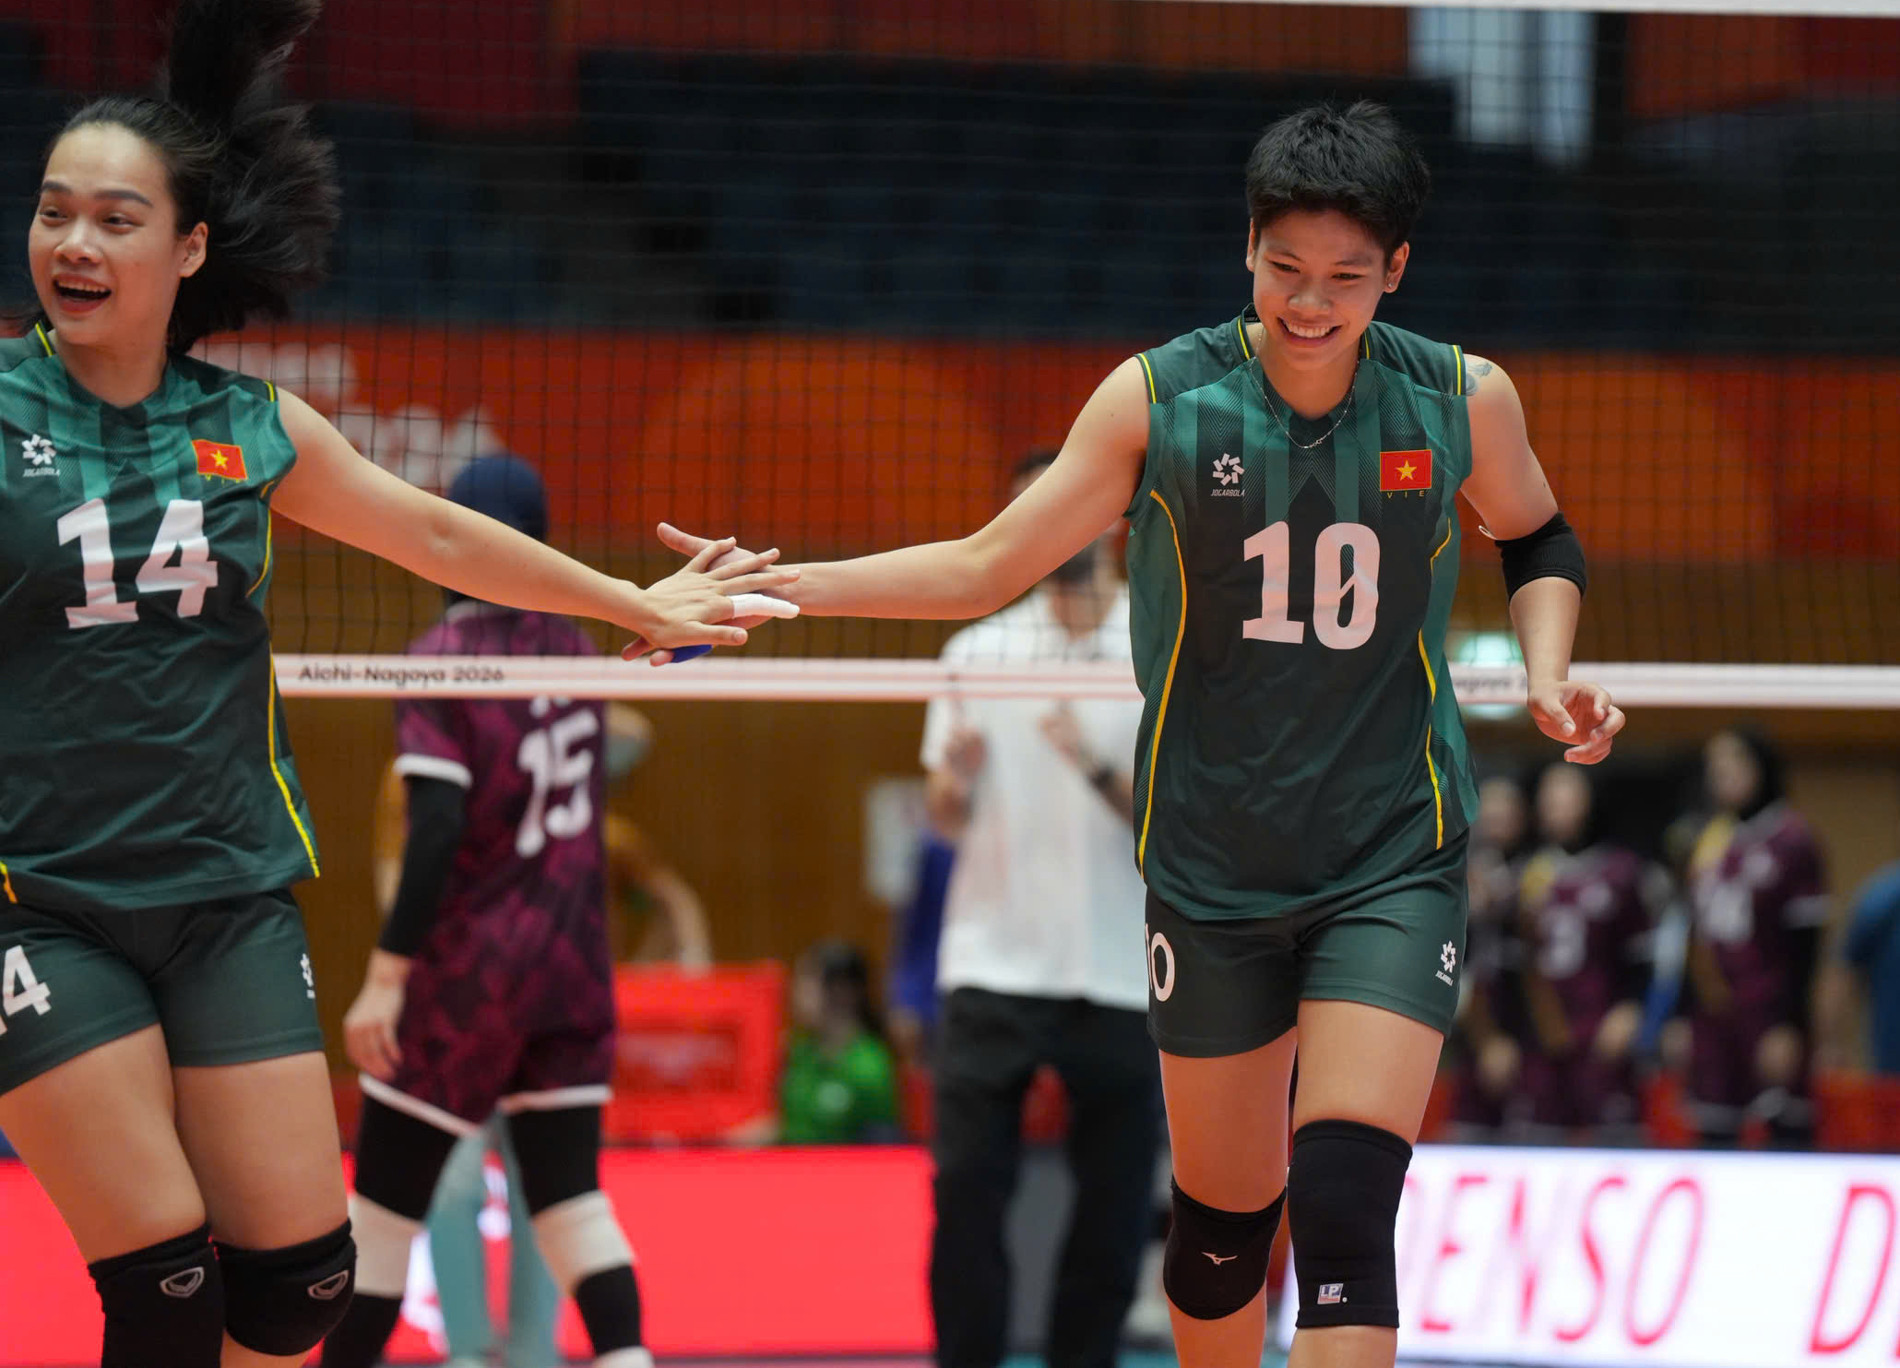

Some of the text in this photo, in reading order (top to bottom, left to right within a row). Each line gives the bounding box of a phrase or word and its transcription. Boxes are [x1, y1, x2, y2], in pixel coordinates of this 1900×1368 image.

[1387, 490, 1425, 499] VIE
[57, 498, 218, 629] 14
[1242, 520, 1380, 650] 10
[299, 662, 505, 688] Aichi-Nagoya 2026
[515, 709, 599, 858] 15
[0, 945, 52, 1036] 4
[1145, 923, 1175, 1001] 0
[1808, 1184, 1900, 1360] D
